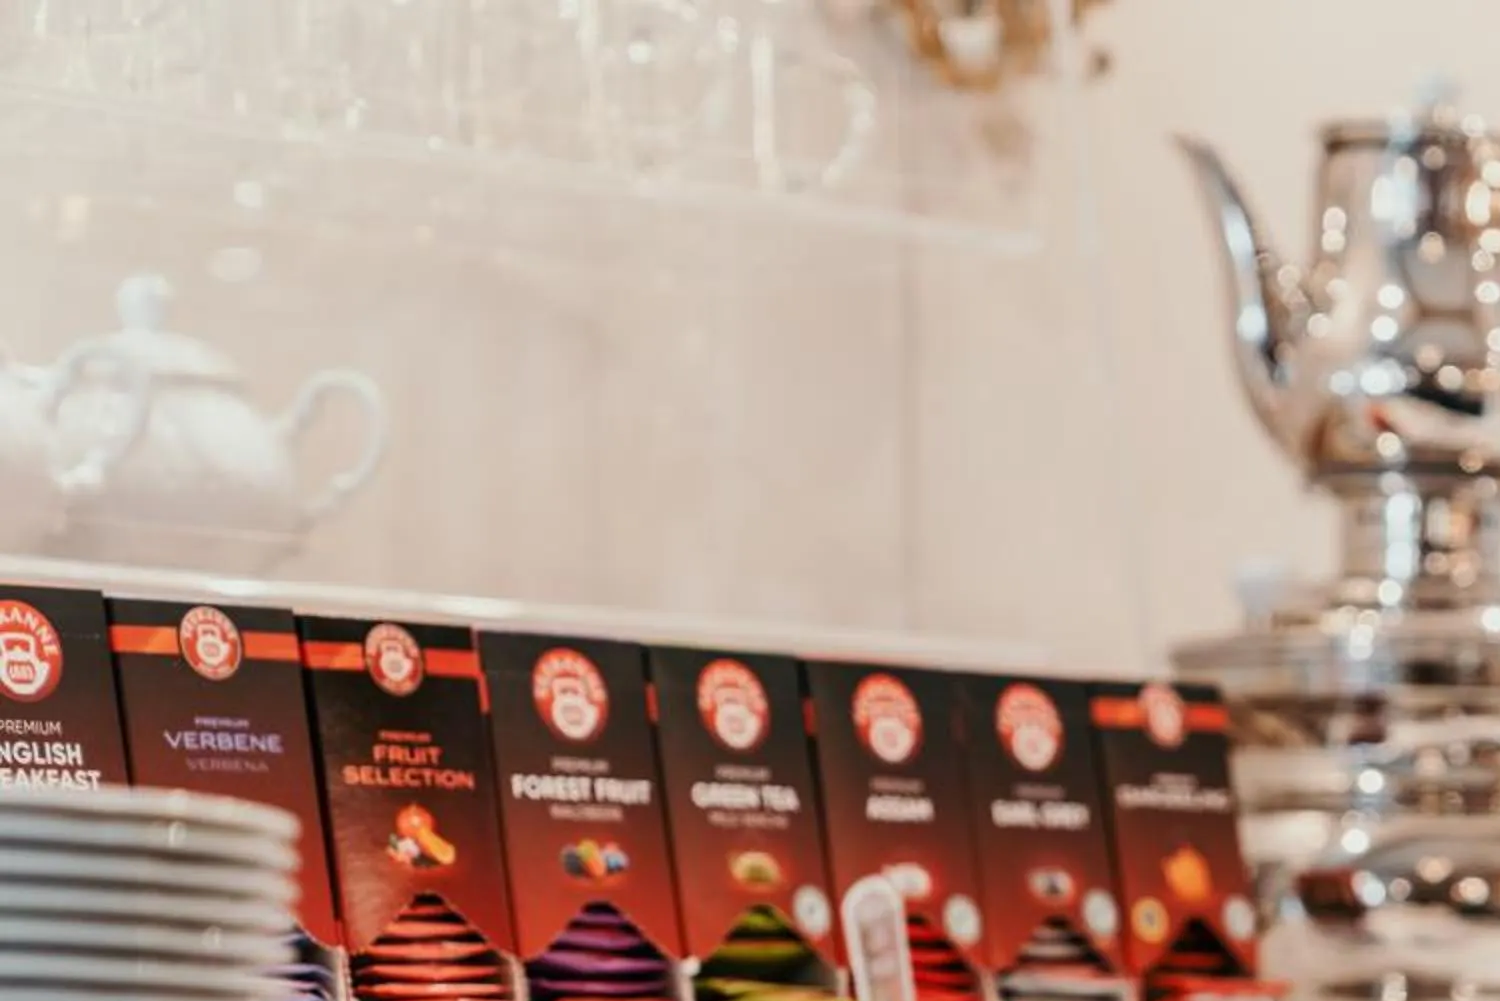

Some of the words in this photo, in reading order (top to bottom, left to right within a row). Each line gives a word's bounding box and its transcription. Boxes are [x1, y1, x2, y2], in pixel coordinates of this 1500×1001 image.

[163, 729, 283, 753] VERBENE
[0, 741, 83, 766] NGLISH
[373, 744, 442, 765] FRUIT
[0, 767, 100, 791] EAKFAST
[343, 765, 475, 789] SELECTION
